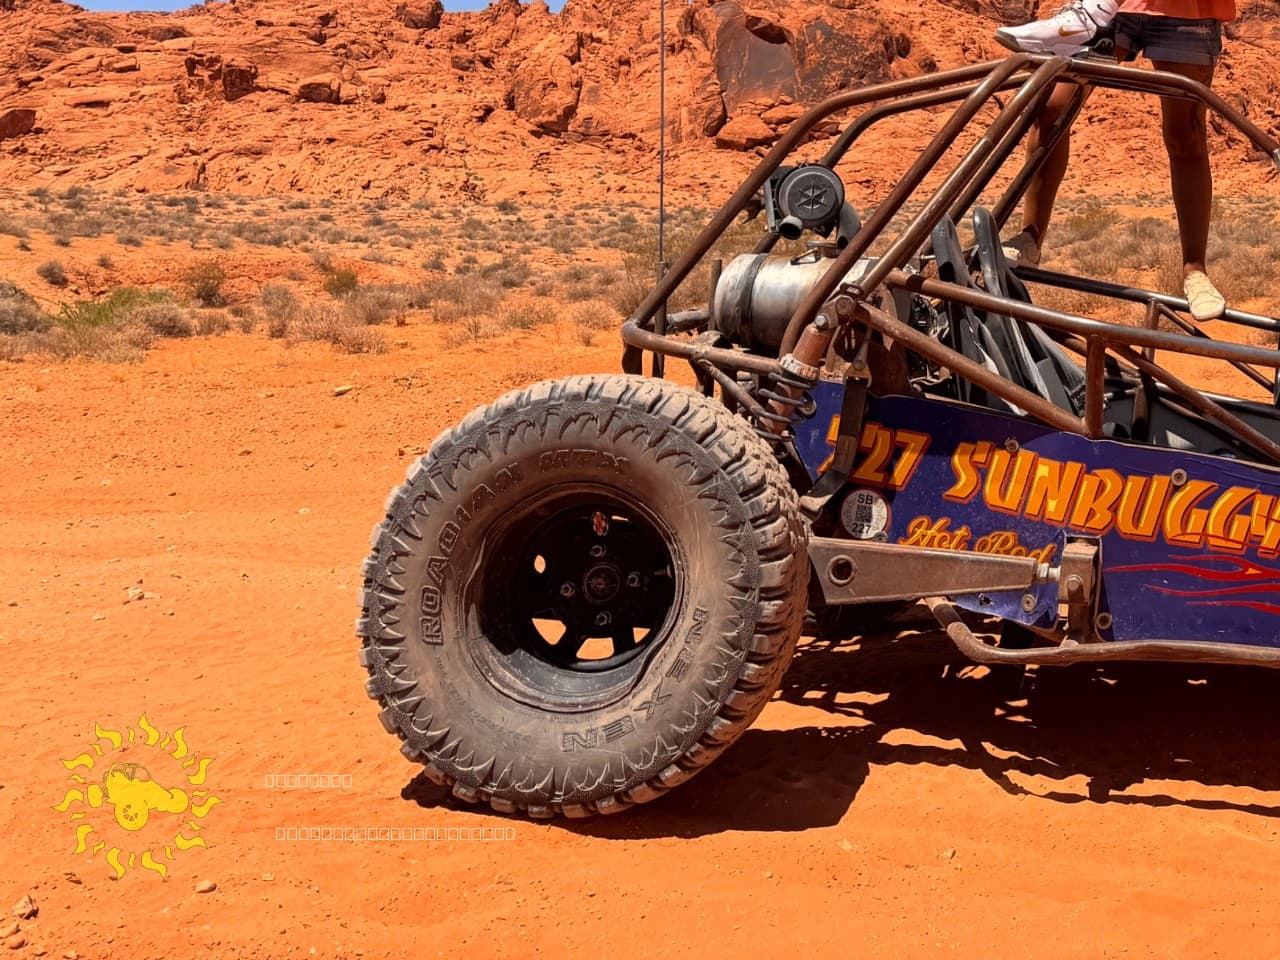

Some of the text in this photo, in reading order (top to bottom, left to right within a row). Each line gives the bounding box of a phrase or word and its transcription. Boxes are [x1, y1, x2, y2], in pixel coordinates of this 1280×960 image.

[851, 522, 872, 535] 227
[857, 493, 874, 505] SB
[419, 462, 522, 646] ROADIAN
[562, 606, 709, 752] NEXEN
